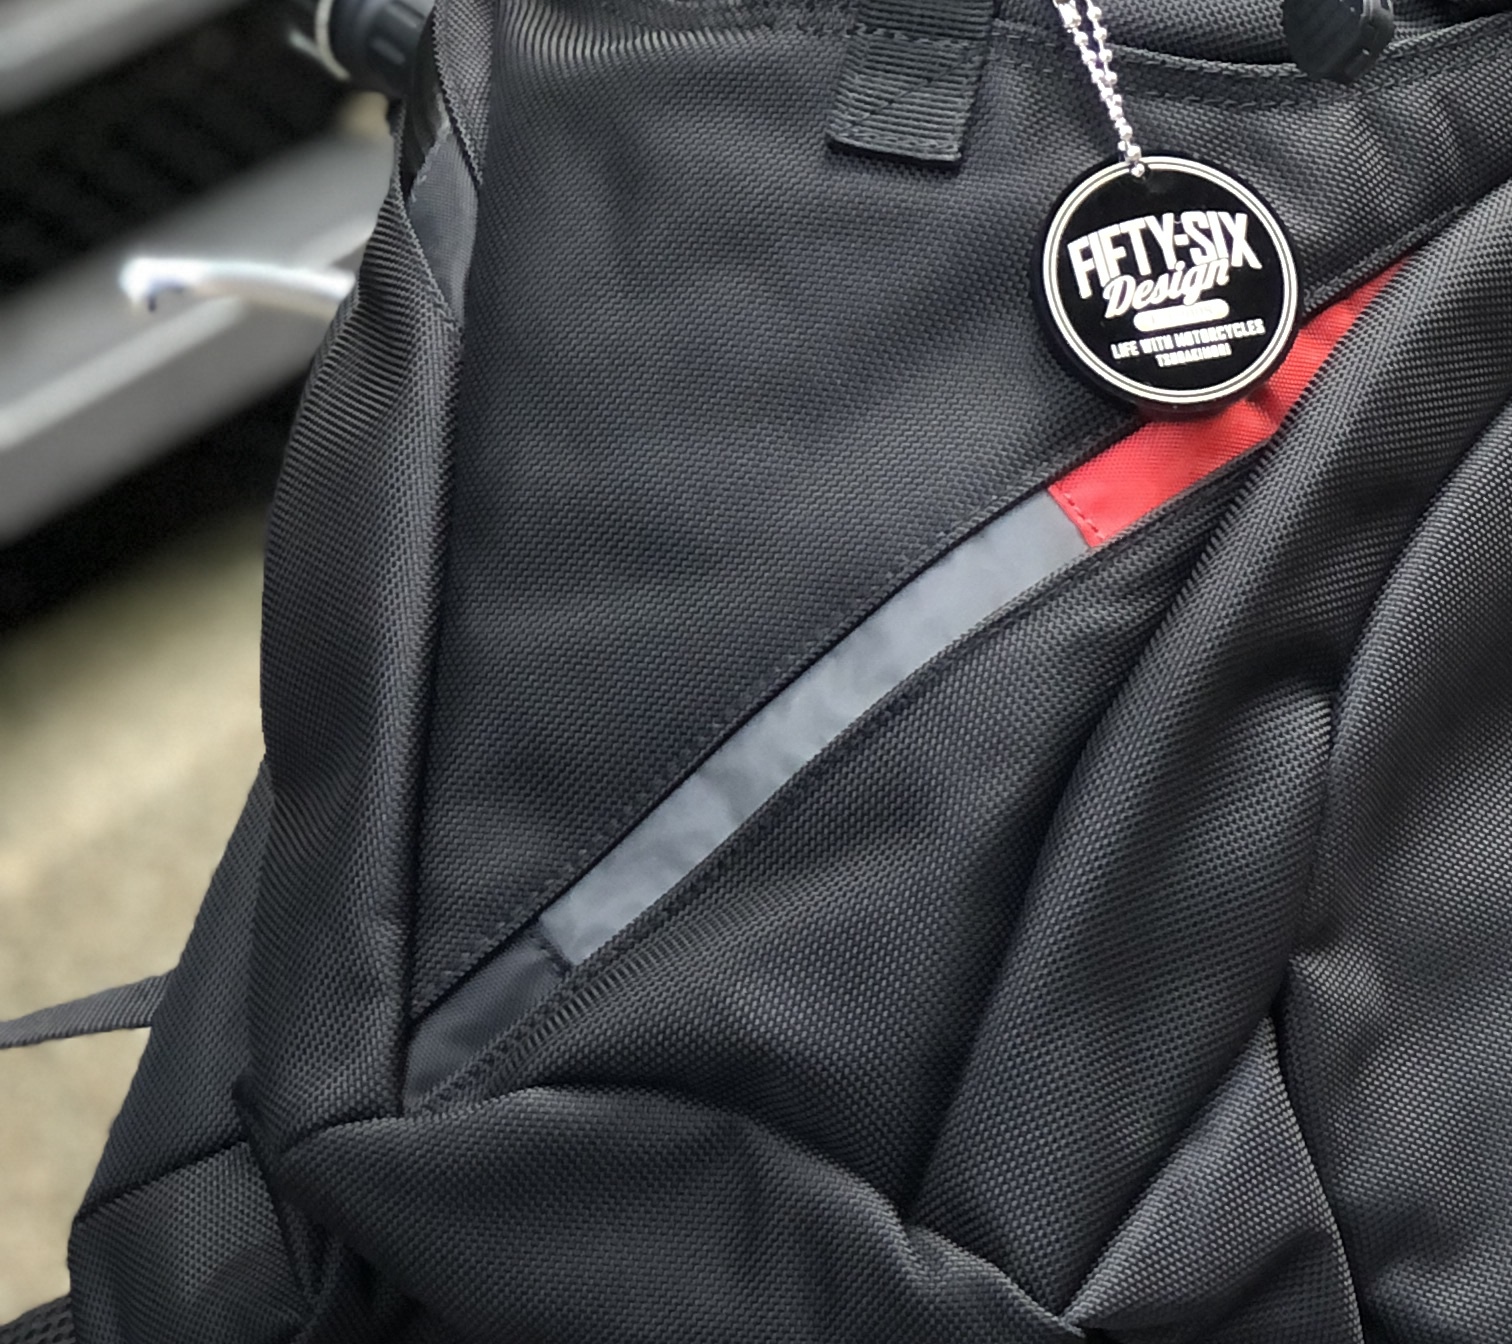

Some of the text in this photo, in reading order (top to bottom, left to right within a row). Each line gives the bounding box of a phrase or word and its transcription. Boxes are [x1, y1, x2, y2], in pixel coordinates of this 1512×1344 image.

[1067, 210, 1262, 299] FIFTY-SIX
[1103, 258, 1230, 319] Design
[1110, 318, 1266, 360] LIFE WITH MOTORCYCLES
